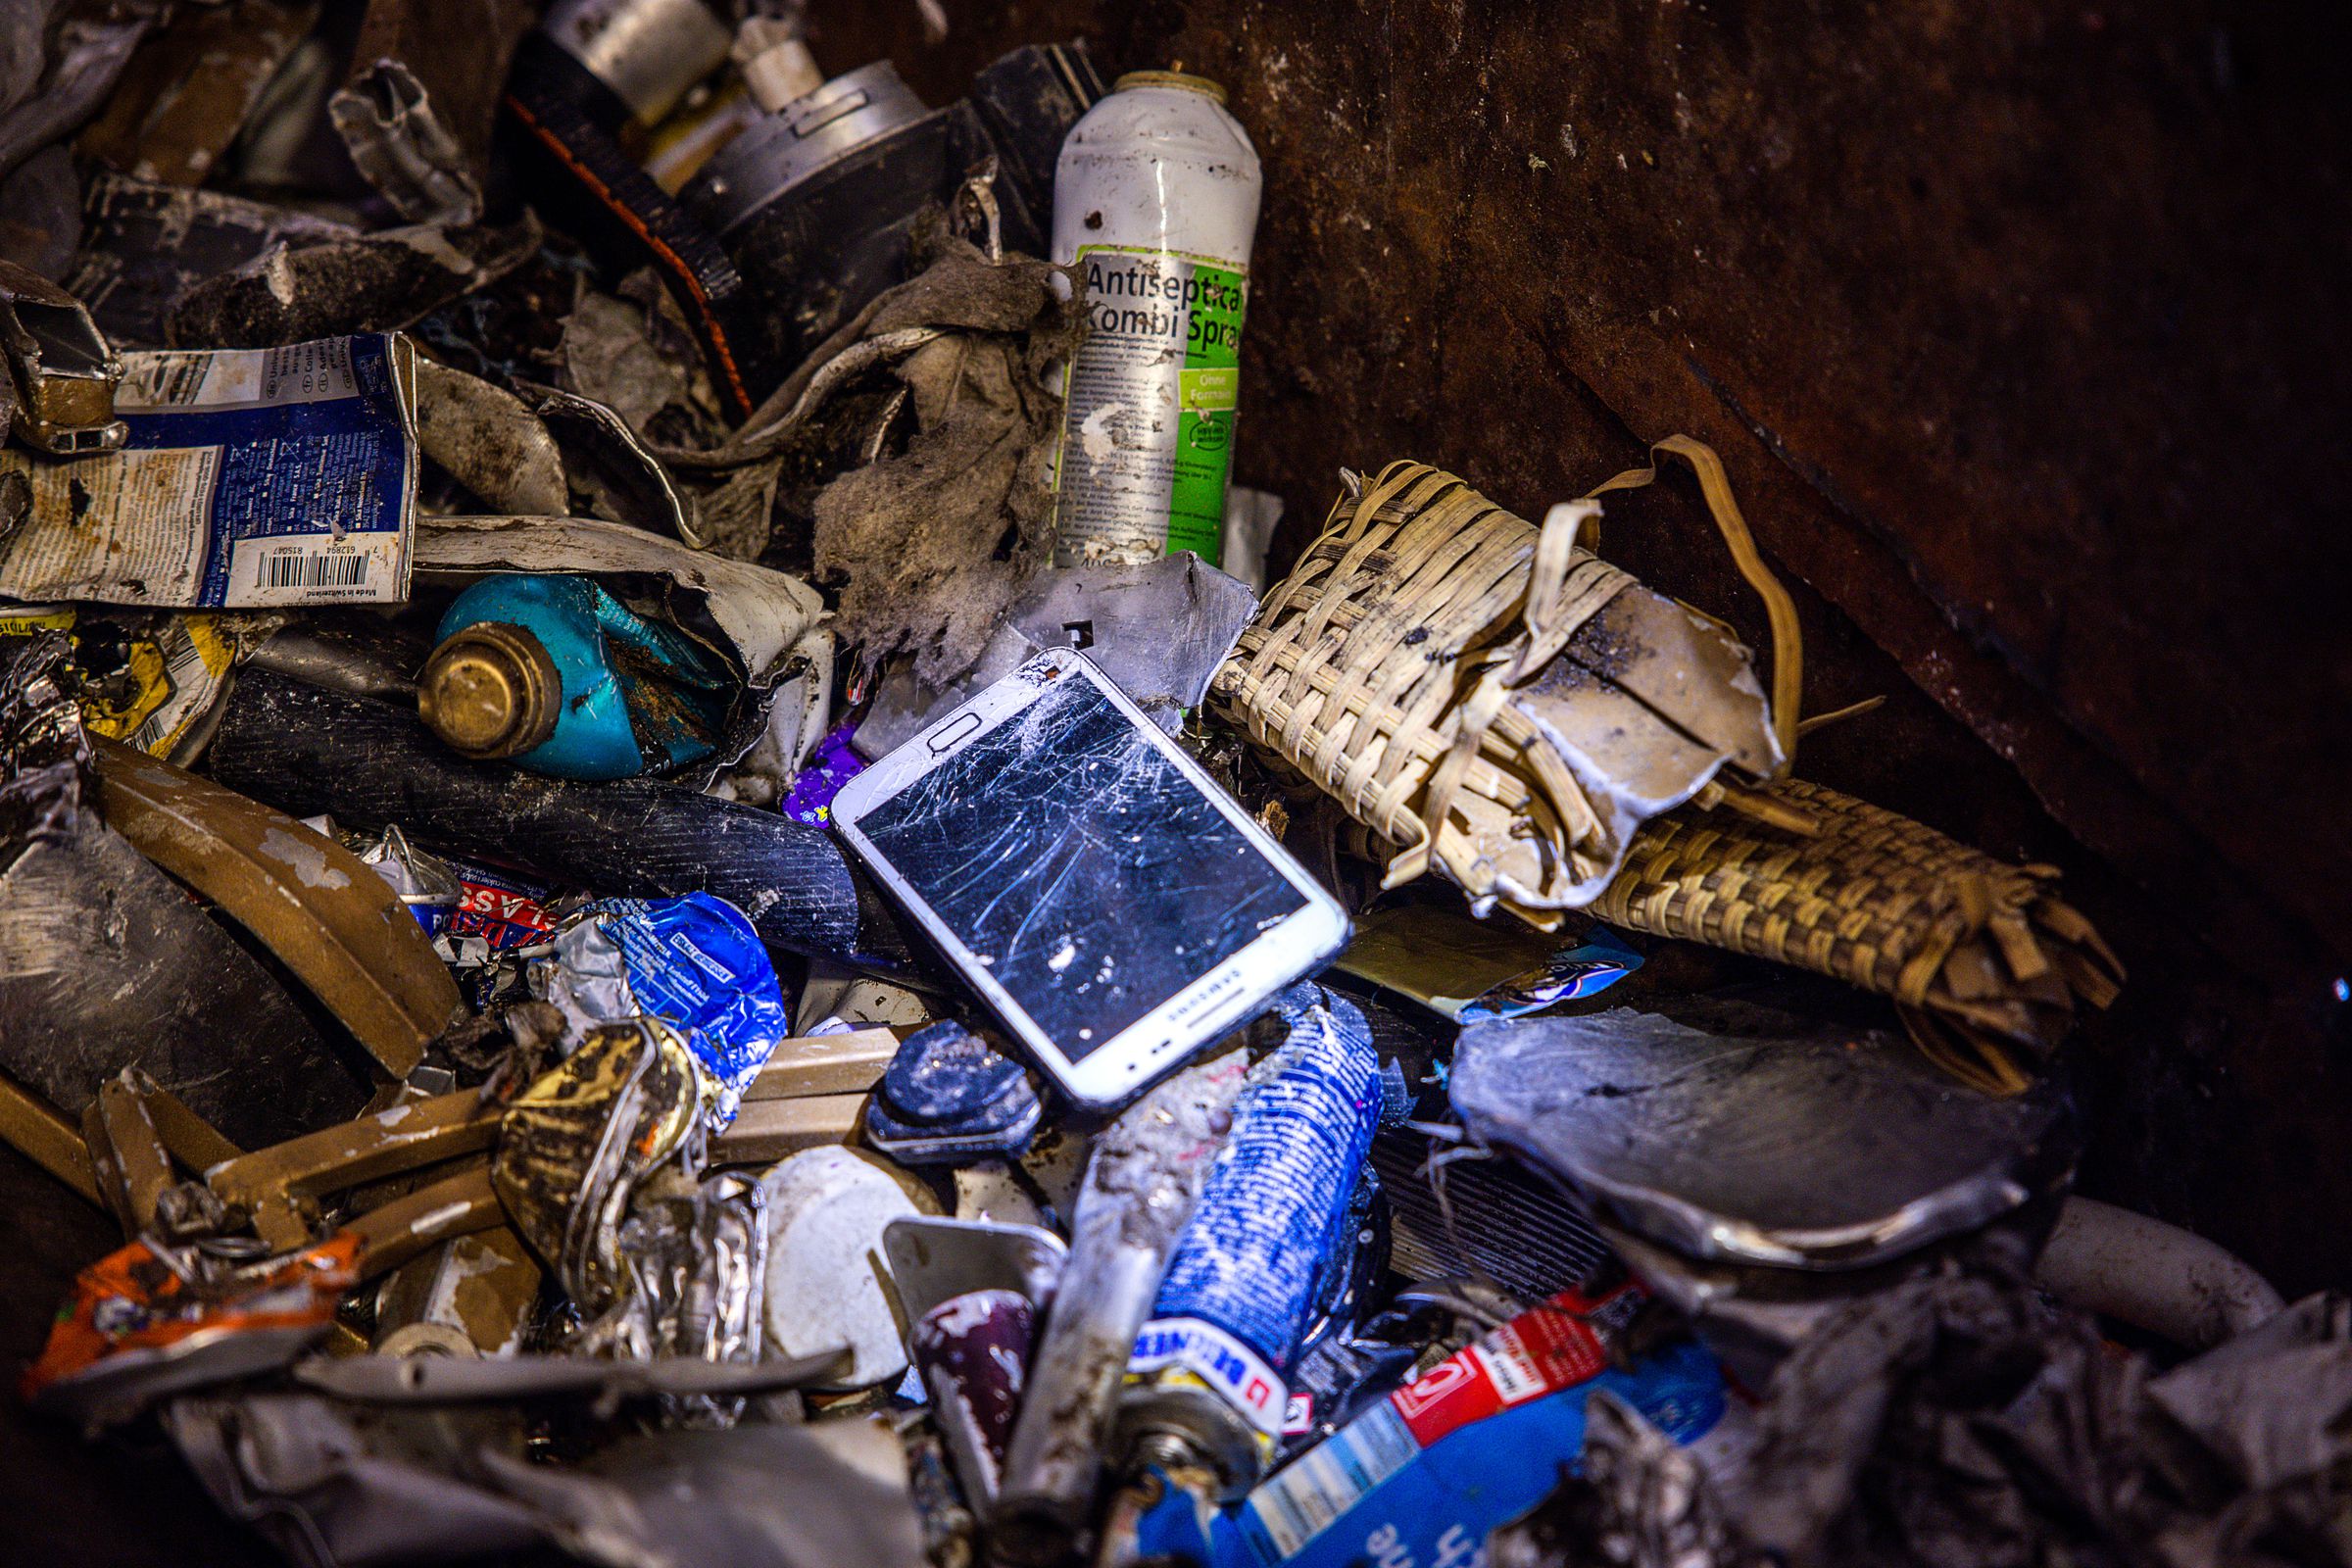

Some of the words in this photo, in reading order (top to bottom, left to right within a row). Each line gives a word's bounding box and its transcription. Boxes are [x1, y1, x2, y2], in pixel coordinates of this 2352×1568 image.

[1088, 264, 1239, 312] Antiseptica
[1187, 310, 1240, 351] Spra
[326, 546, 355, 555] 612894
[307, 589, 346, 598] Switzerland
